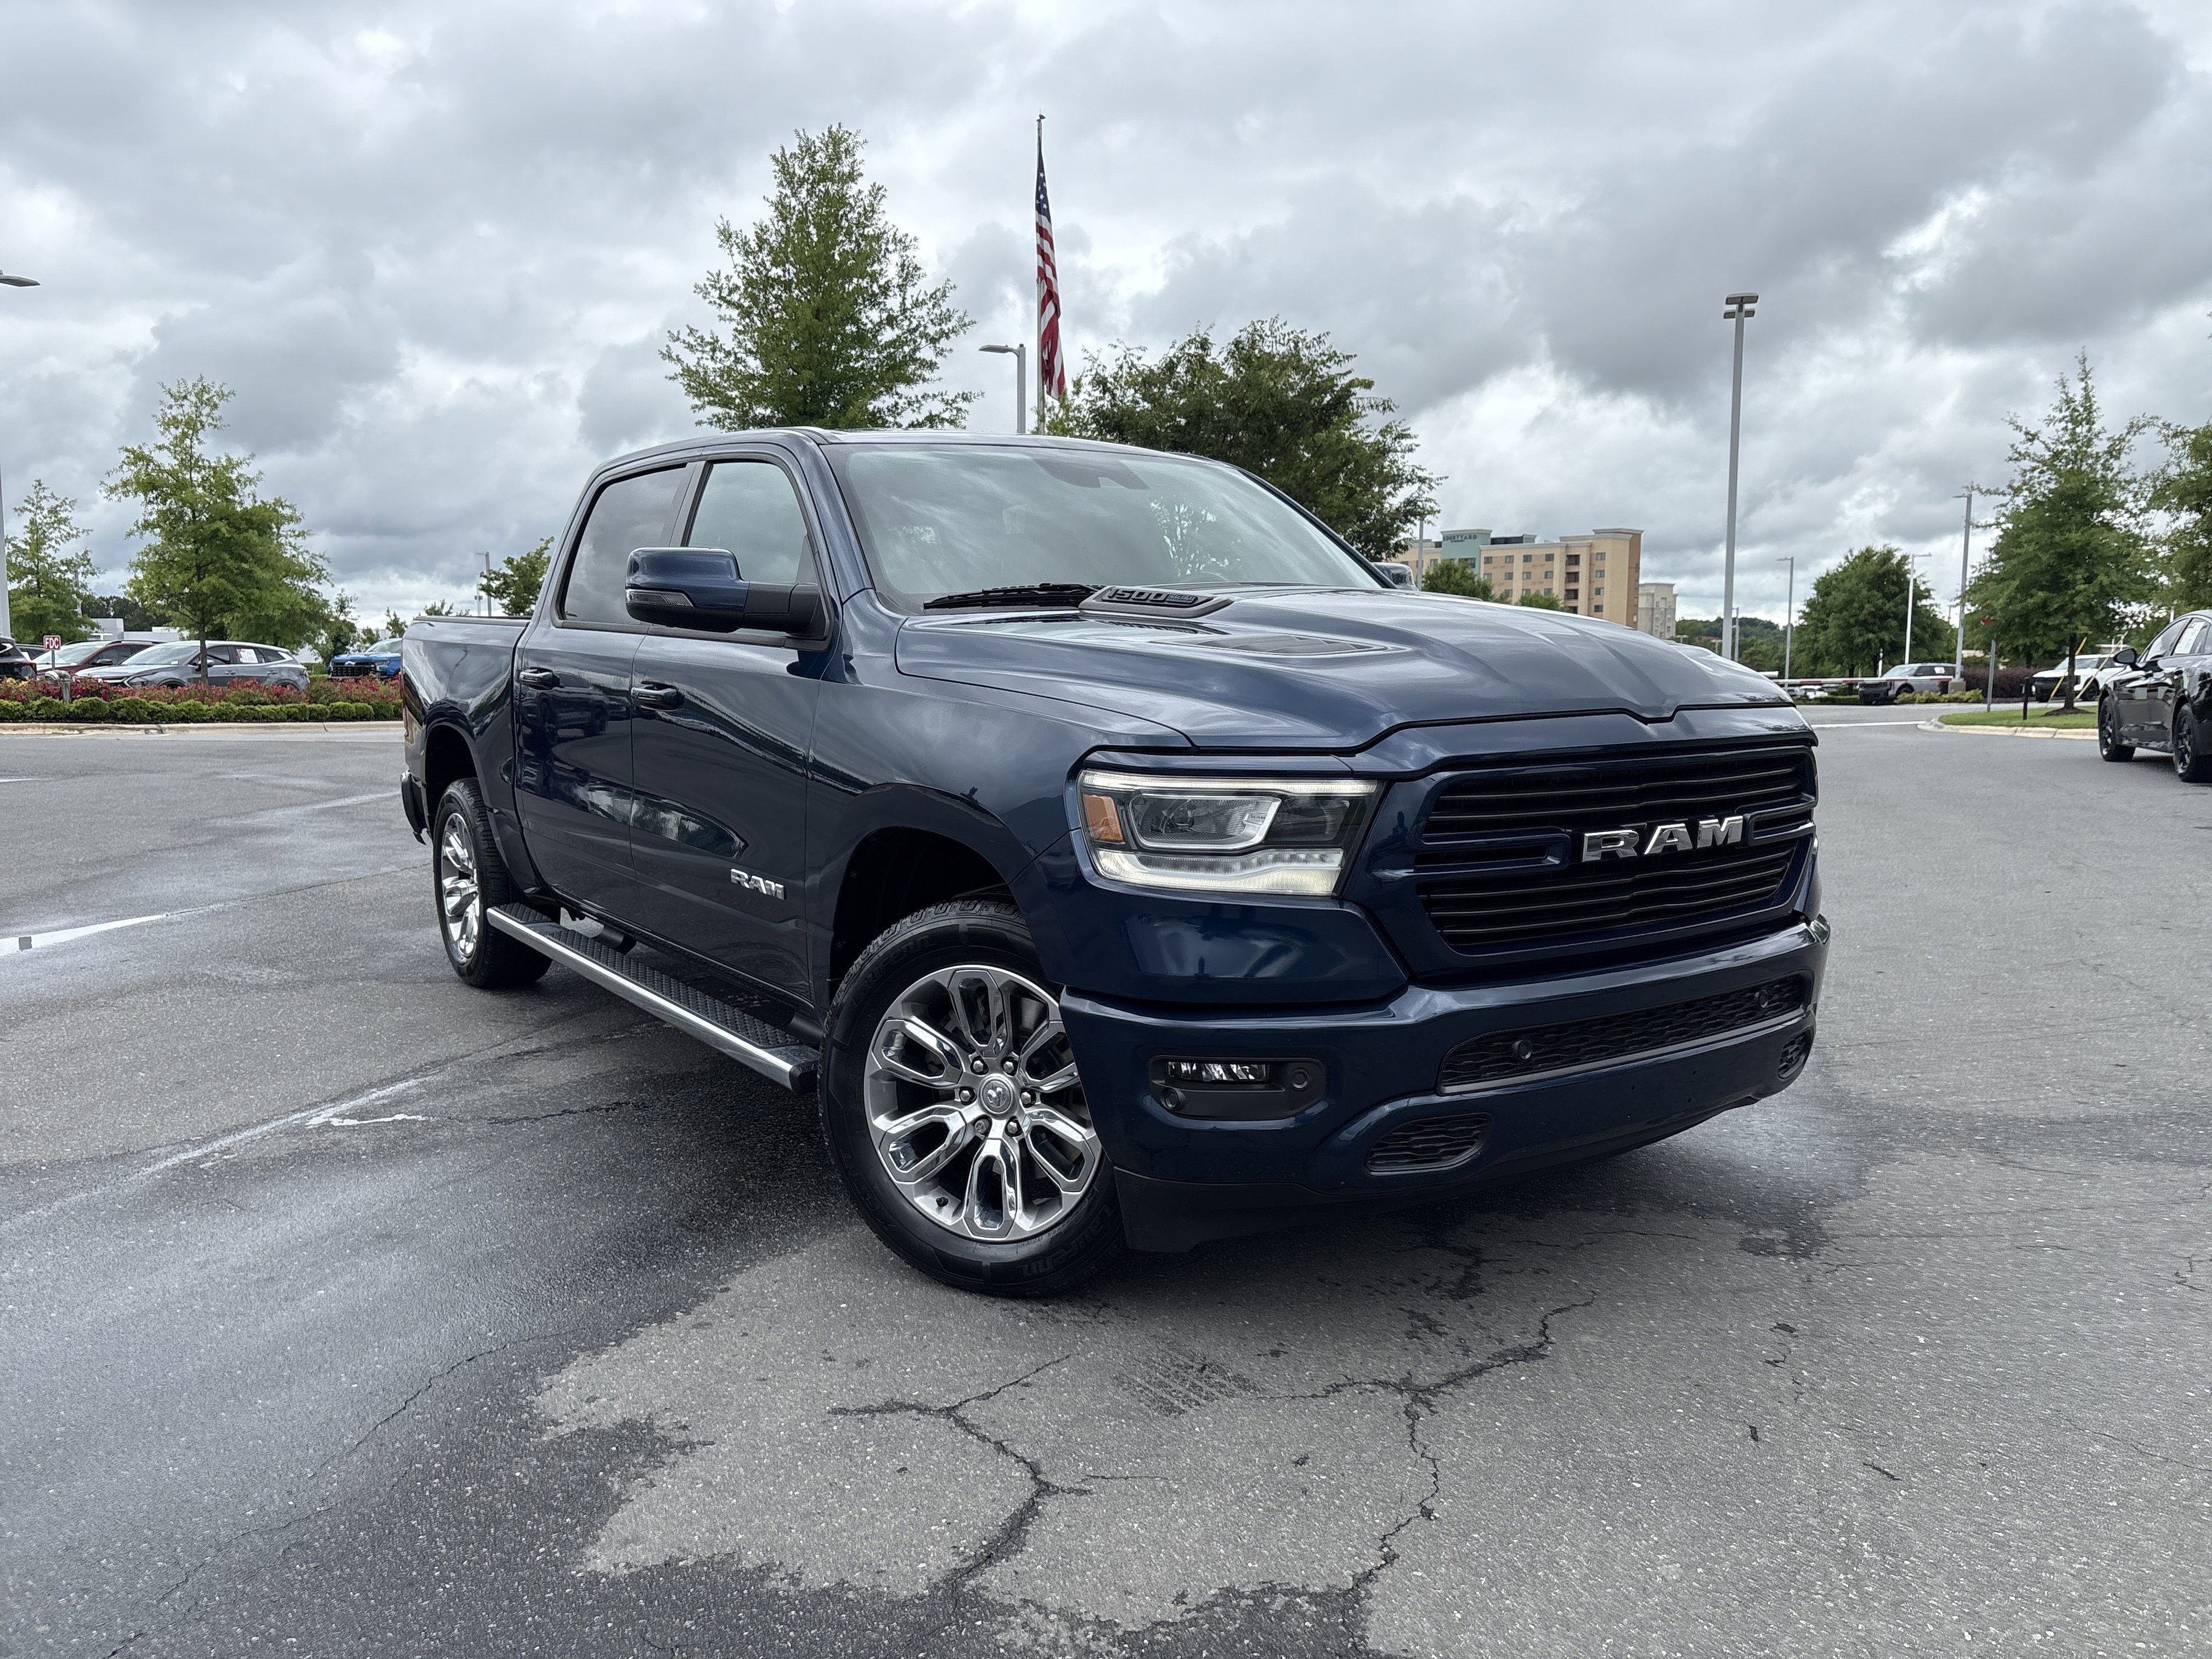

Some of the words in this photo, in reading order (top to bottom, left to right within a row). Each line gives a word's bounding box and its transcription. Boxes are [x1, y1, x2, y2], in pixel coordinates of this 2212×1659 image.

[1107, 588, 1168, 601] 1500
[45, 637, 59, 649] FDC
[1582, 815, 1744, 862] RAM
[730, 868, 786, 900] RAM
